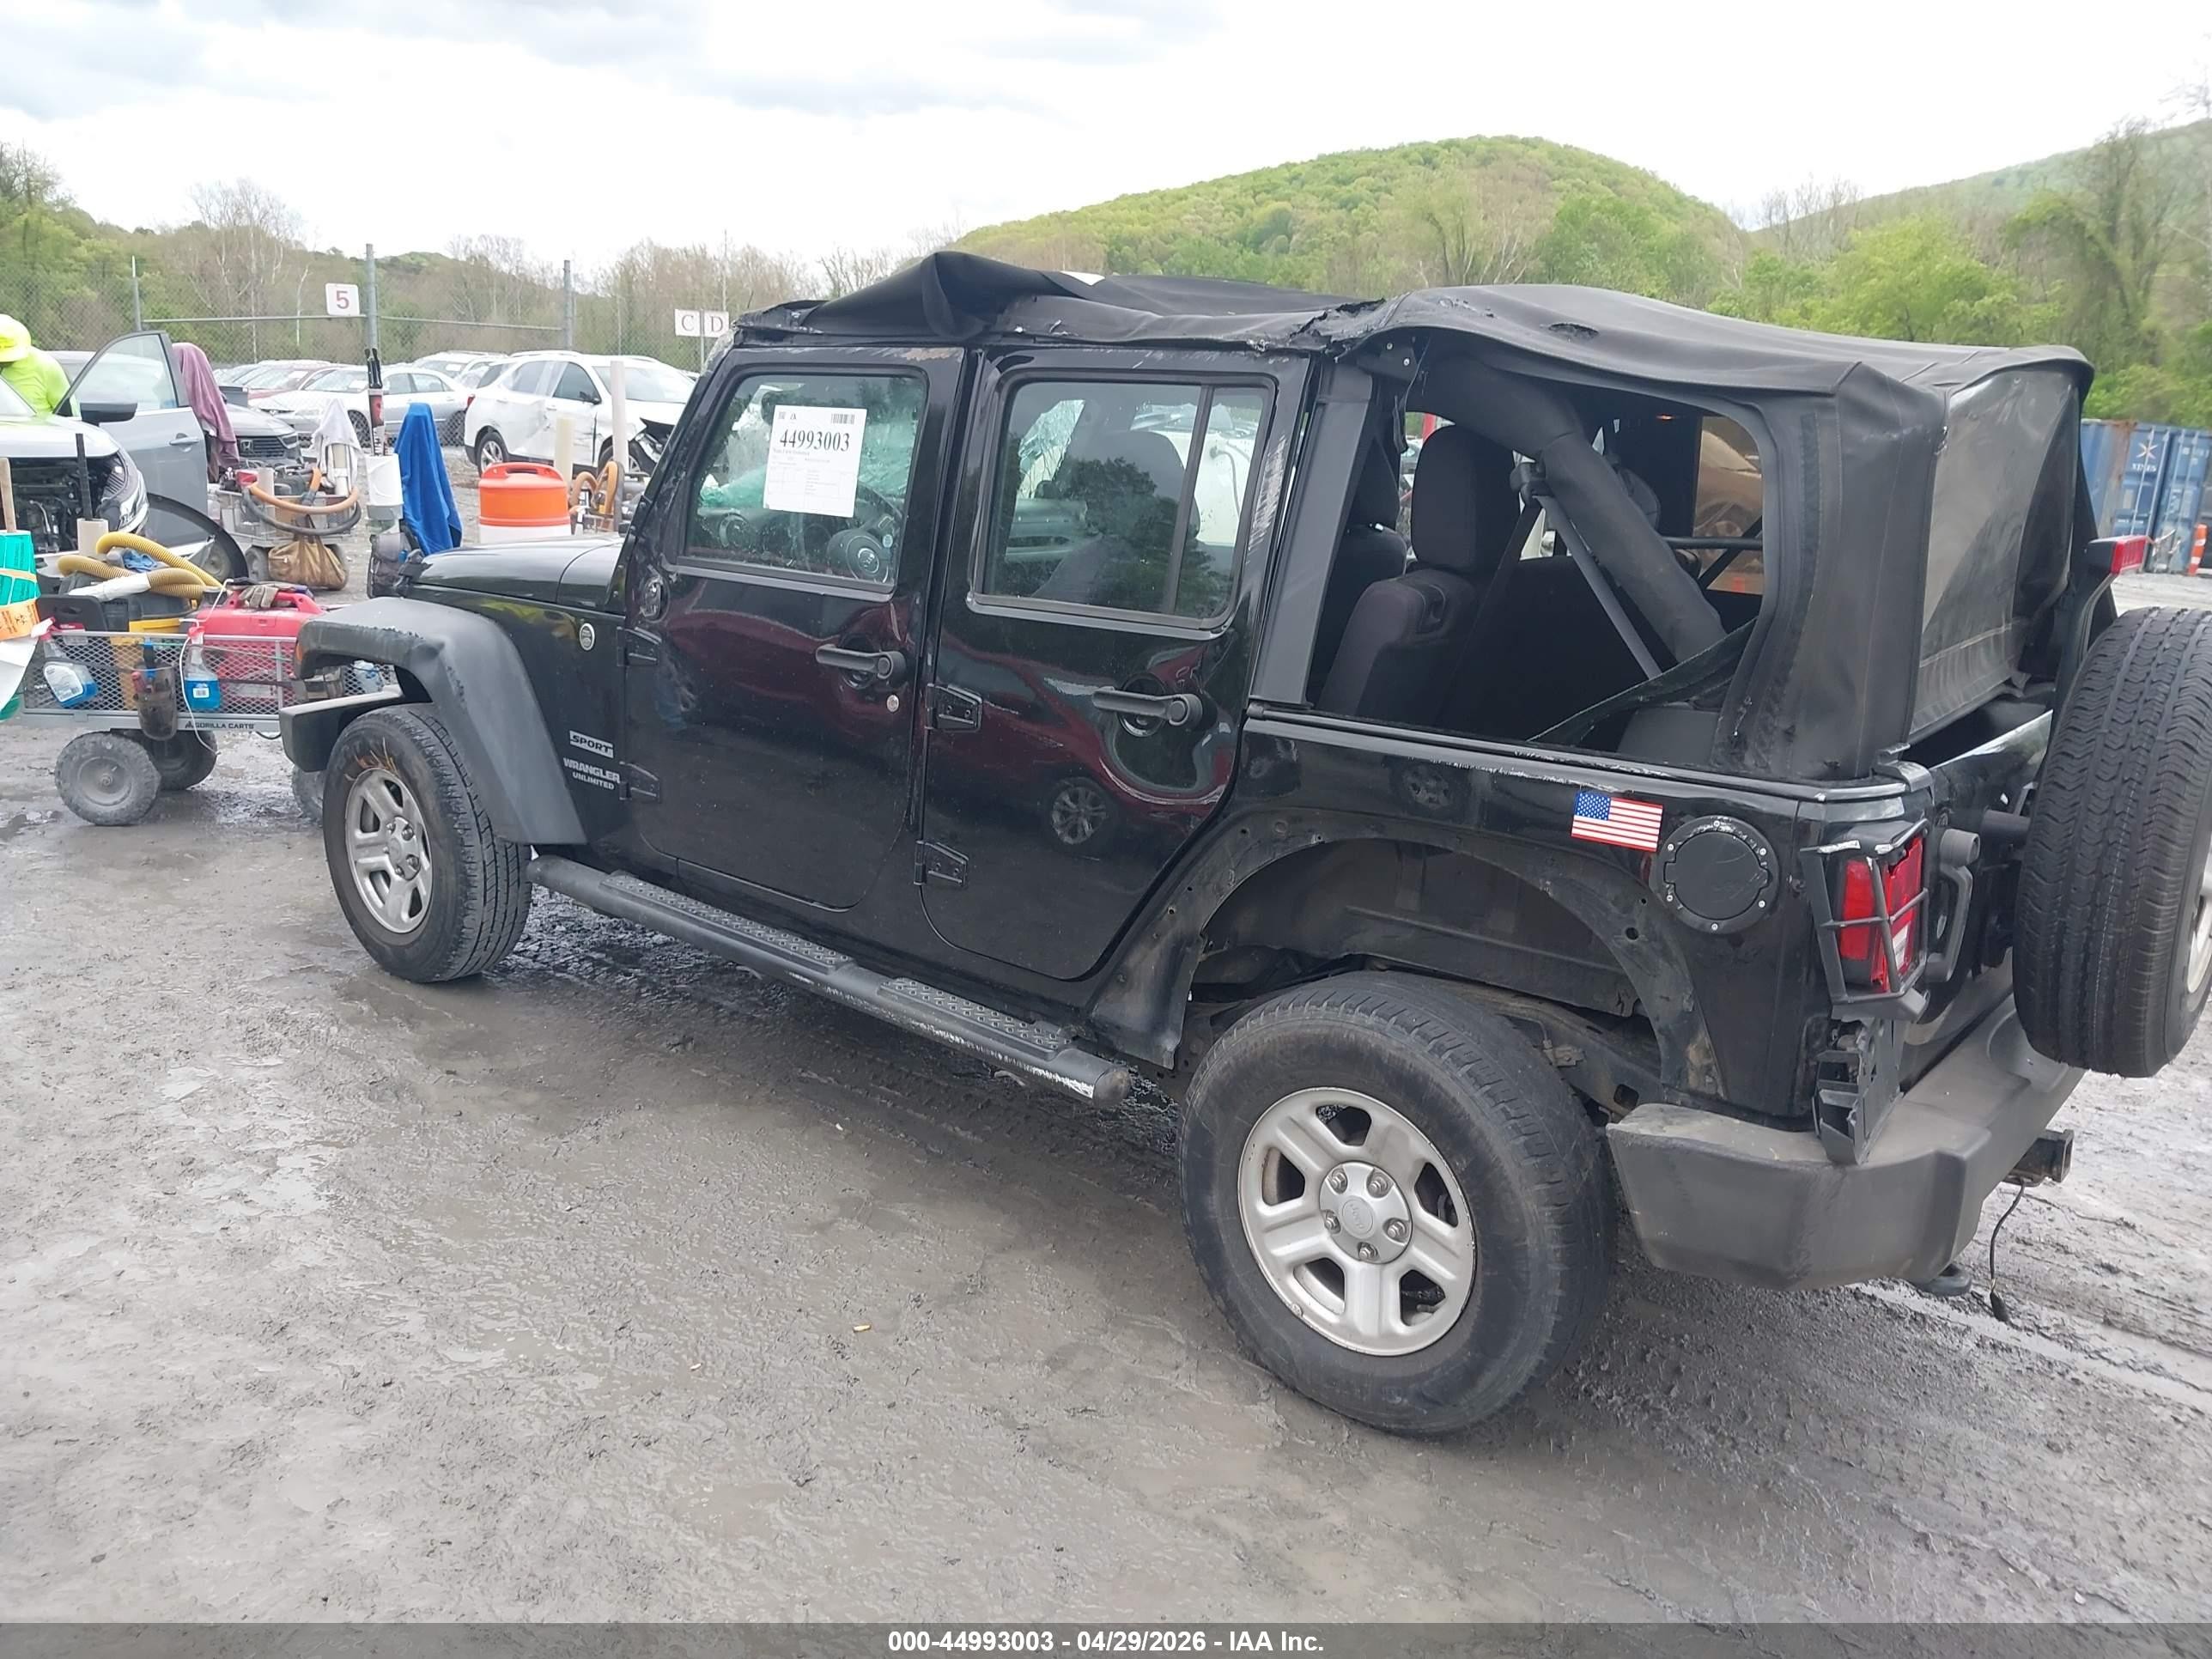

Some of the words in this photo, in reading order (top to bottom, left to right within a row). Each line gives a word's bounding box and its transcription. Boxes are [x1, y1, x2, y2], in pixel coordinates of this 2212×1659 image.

[335, 290, 350, 309] 5
[681, 314, 694, 331] C
[709, 315, 723, 332] D
[780, 428, 850, 452] 44993003
[570, 733, 613, 754] SPORT
[562, 757, 621, 784] WRANGLER
[572, 771, 615, 790] UNLIMITED
